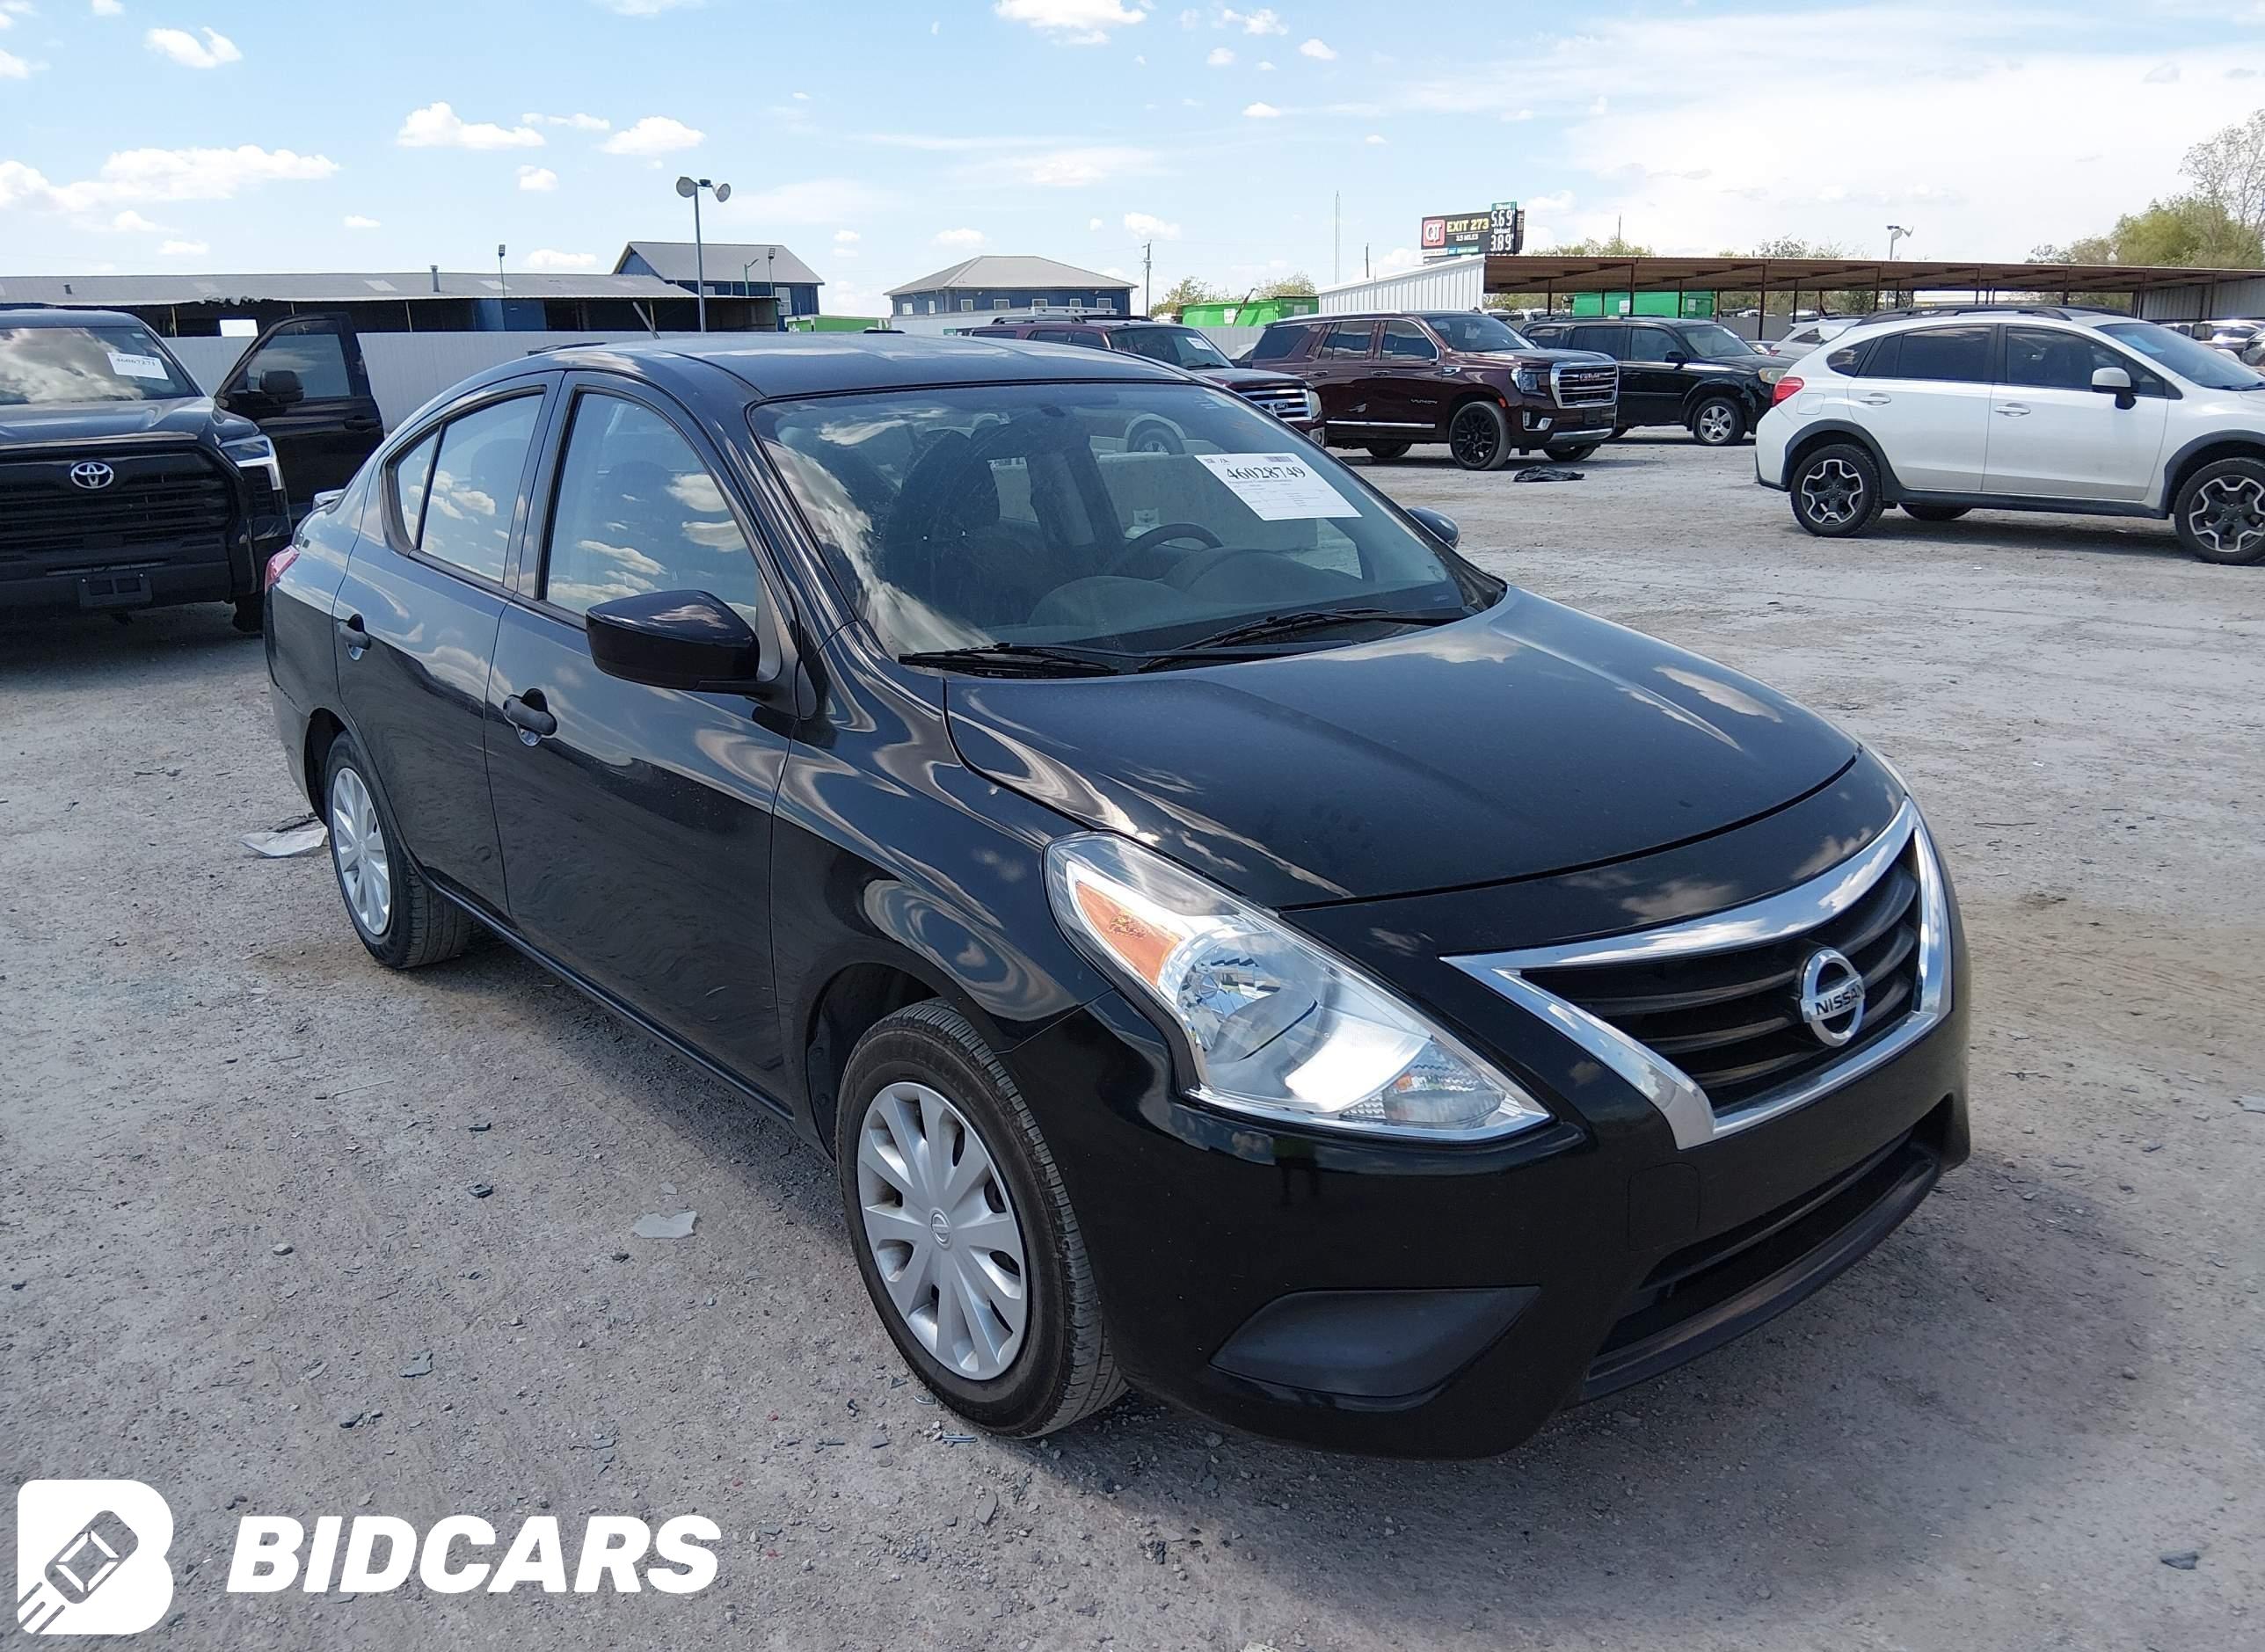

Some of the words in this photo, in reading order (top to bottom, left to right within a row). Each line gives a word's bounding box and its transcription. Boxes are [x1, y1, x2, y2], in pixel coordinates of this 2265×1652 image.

[1446, 220, 1469, 232] EXIT
[1470, 218, 1489, 230] 273
[1425, 223, 1442, 242] QT
[1227, 466, 1307, 480] 46028749
